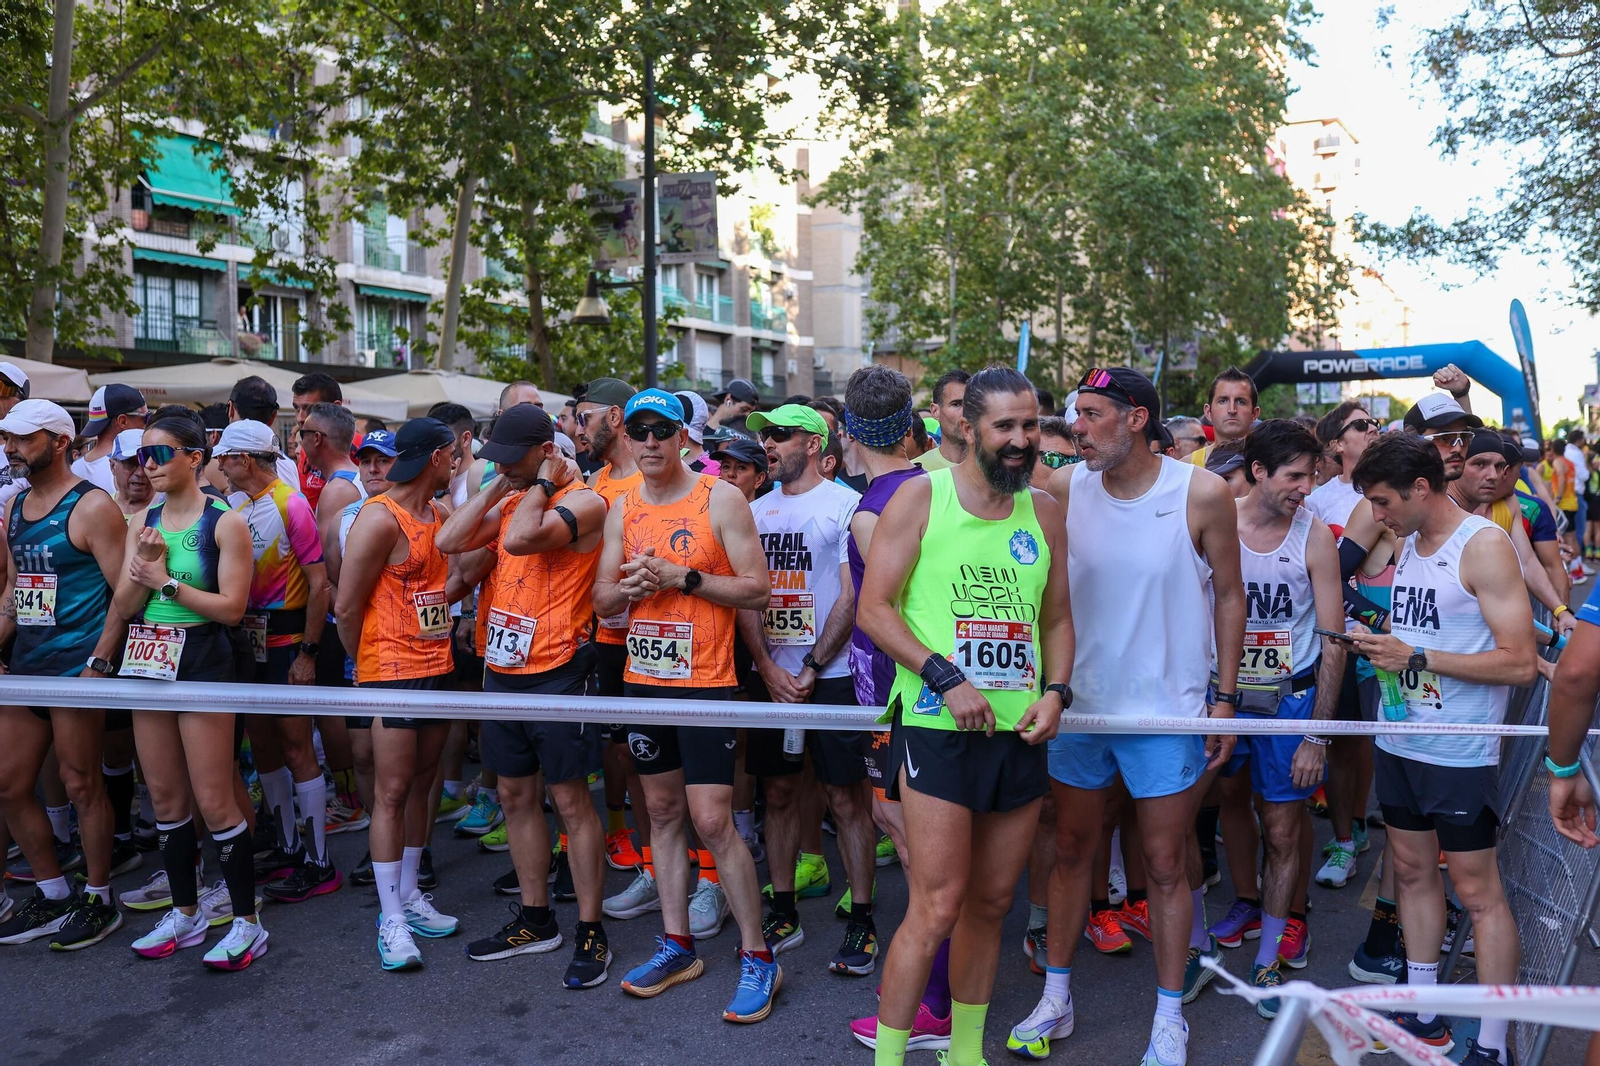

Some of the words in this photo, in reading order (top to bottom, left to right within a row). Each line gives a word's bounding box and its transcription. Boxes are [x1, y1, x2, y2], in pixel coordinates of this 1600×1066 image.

[1303, 354, 1425, 375] POWERADE
[633, 395, 667, 409] HOKA
[366, 431, 388, 442] NY
[759, 532, 808, 552] TRAIL
[960, 563, 1018, 585] NEW
[951, 582, 1024, 612] YORK
[1391, 585, 1441, 630] ENA
[973, 623, 988, 632] MEDIA
[987, 624, 1009, 633] MARATÓN
[127, 640, 168, 663] 1003
[628, 636, 679, 662] 3654
[957, 640, 1027, 670] 1605
